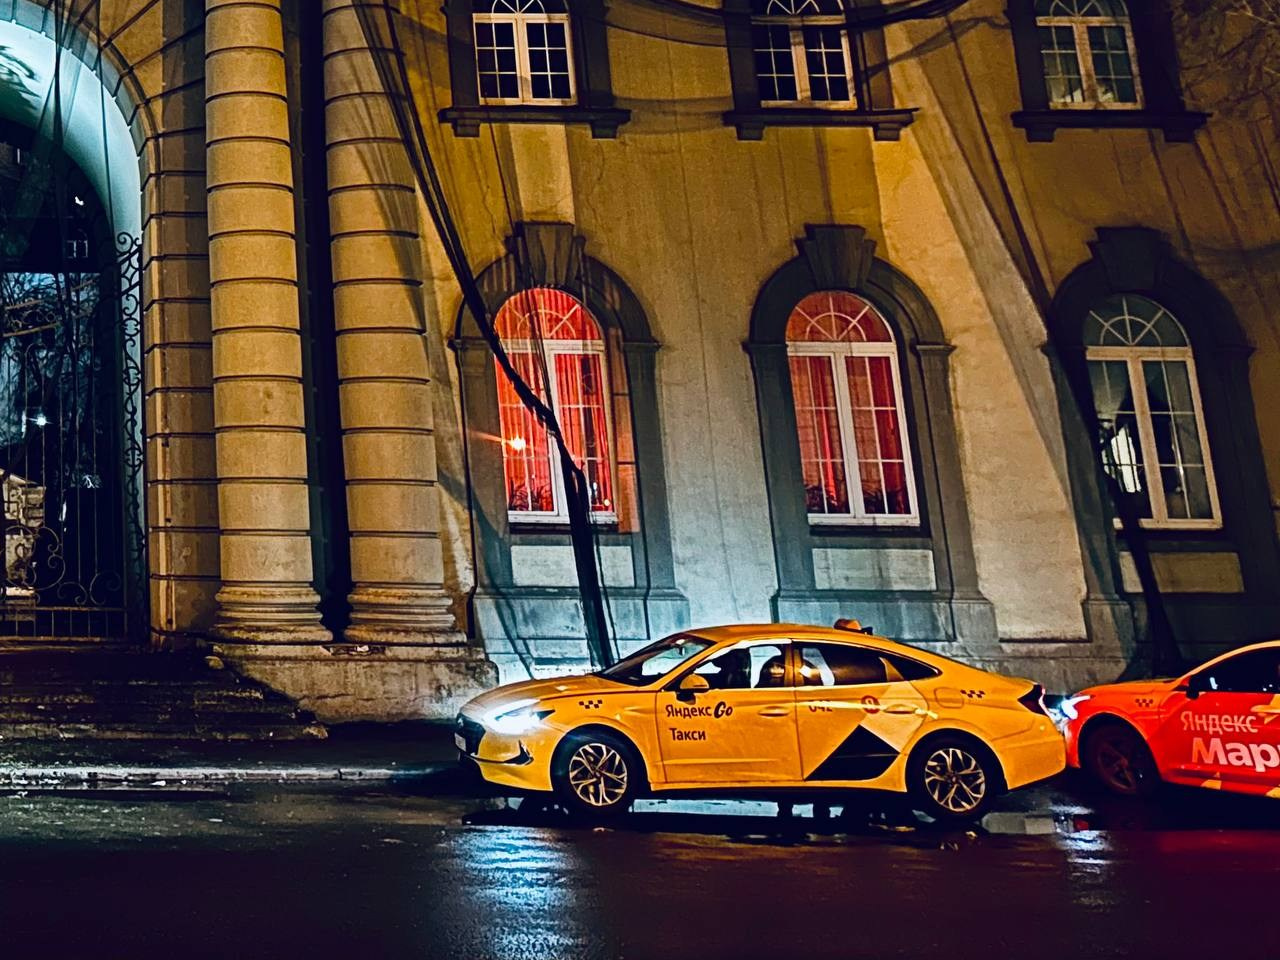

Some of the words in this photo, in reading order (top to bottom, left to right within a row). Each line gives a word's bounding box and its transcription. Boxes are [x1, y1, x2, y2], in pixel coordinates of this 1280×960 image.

[665, 704, 712, 719] Яндекс
[713, 701, 733, 719] Go
[1180, 711, 1258, 735] Яндекс
[669, 728, 706, 741] Такси
[1192, 737, 1280, 772] Мар
